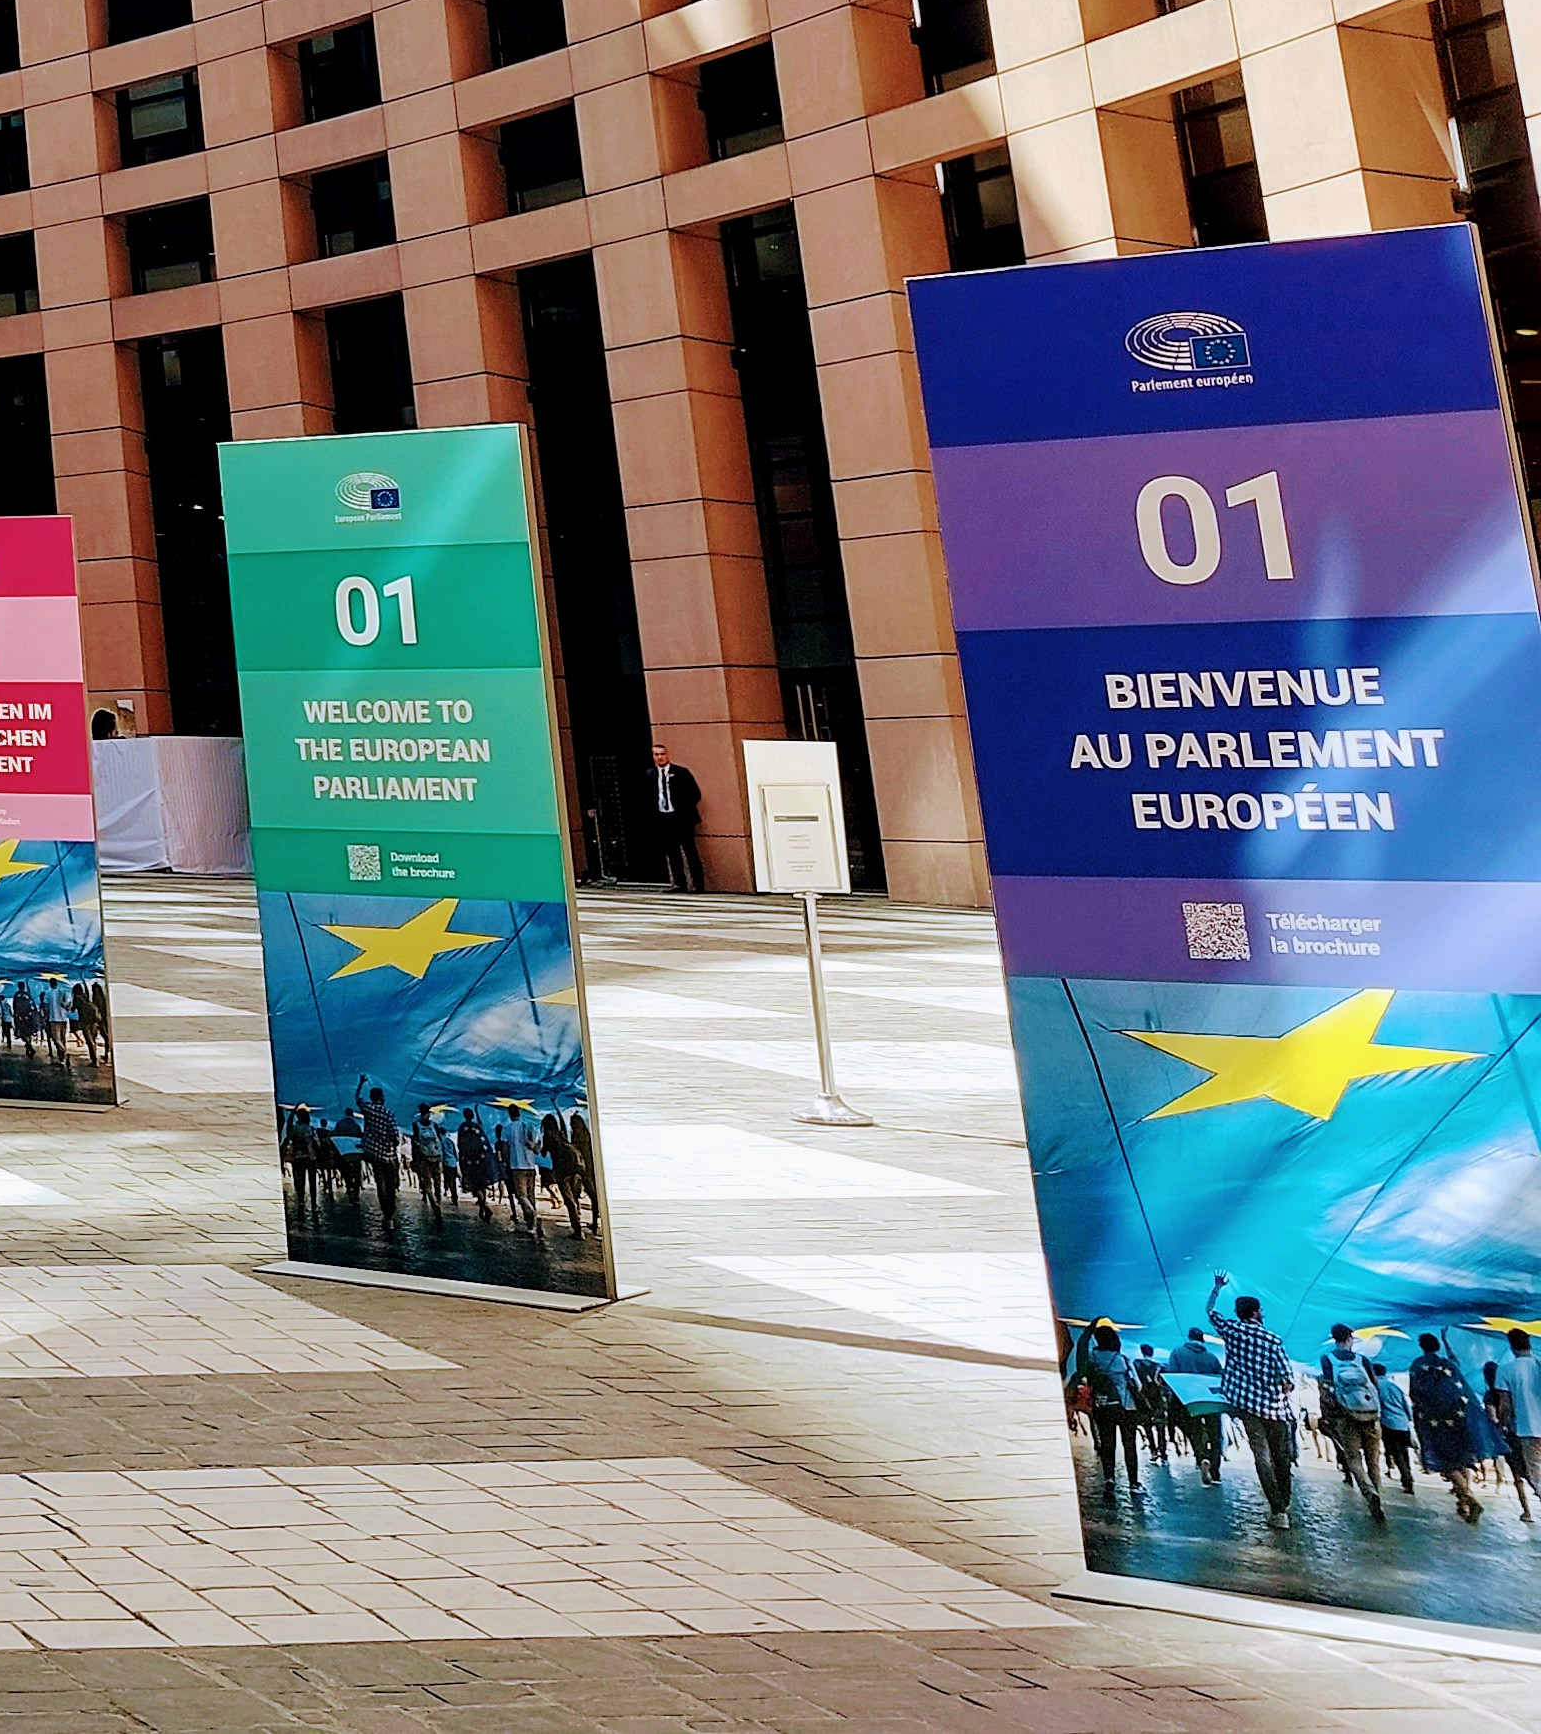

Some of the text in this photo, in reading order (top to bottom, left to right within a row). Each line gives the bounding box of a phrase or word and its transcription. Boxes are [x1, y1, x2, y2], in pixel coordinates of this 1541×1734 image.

[1131, 372, 1254, 392] Parlement européen
[1134, 469, 1296, 586] 01
[335, 575, 418, 646] 01
[1104, 667, 1385, 710] BIENVENUE
[29, 702, 52, 720] IM
[303, 699, 473, 724] WELCOME TO
[294, 737, 491, 764] THE EUROPEAN
[1070, 728, 1444, 770] AU PARLEMENT
[313, 775, 478, 802] PARLIAMENT
[1130, 783, 1396, 832] EUROPÉEN
[390, 851, 440, 864] Download
[392, 866, 456, 879] the brochure
[1265, 913, 1382, 935] Télécharger
[1270, 935, 1381, 956] la brochure
